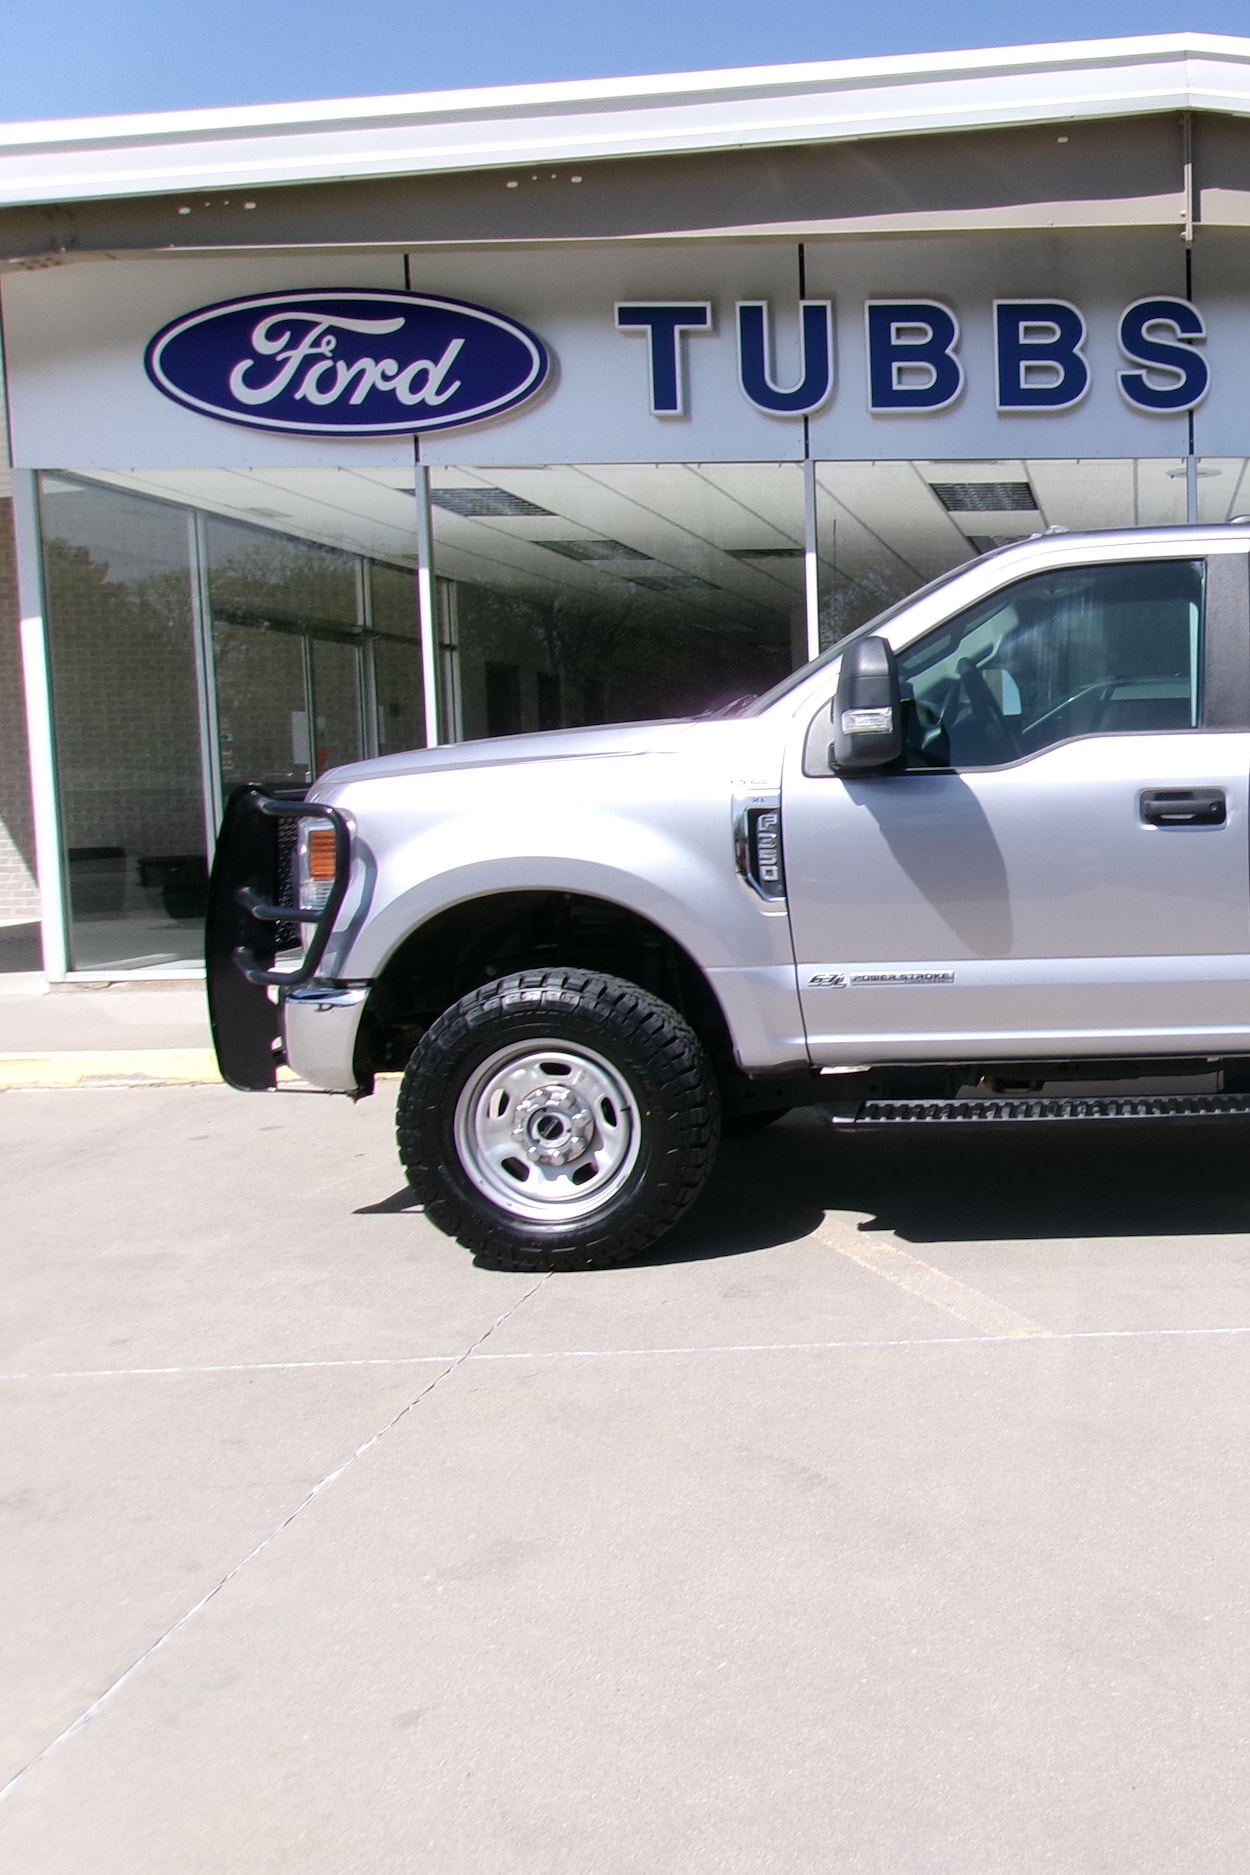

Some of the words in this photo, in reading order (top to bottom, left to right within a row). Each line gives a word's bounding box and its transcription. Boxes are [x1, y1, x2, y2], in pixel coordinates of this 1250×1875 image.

[230, 311, 467, 407] Ford
[613, 295, 1211, 419] TUBBS
[852, 974, 898, 983] POWER
[899, 972, 950, 982] STROKE
